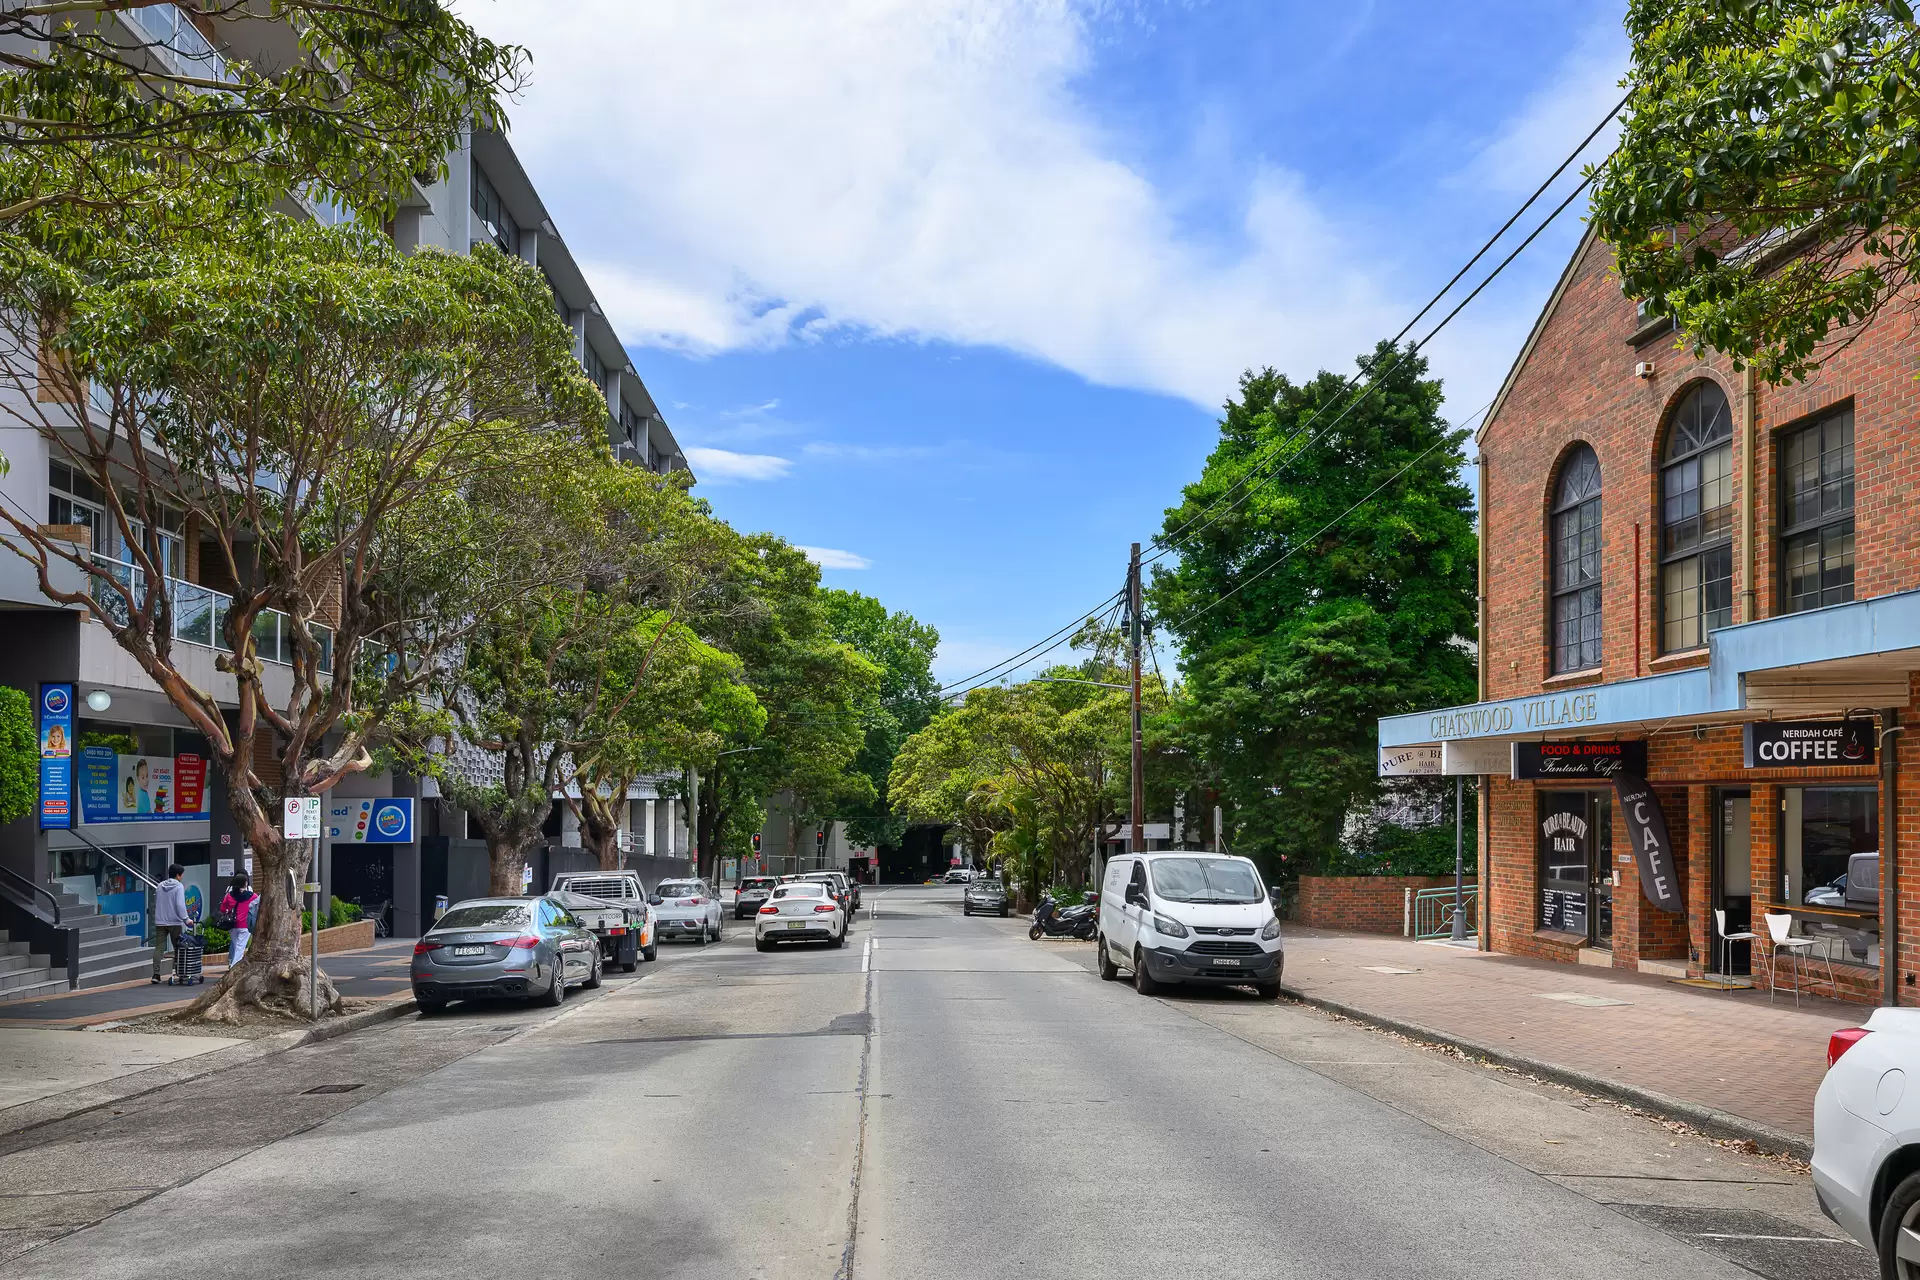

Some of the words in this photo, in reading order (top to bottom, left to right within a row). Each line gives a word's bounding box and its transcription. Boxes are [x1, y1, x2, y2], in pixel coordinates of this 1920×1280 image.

[1430, 706, 1513, 739] CHATSWOOD
[1523, 693, 1597, 727] VILLAGE
[1782, 729, 1820, 738] NERIDAH
[1822, 727, 1843, 738] CAFÉ
[1541, 746, 1570, 755] FOOD
[1572, 746, 1580, 754] &
[1584, 745, 1621, 754] DRINKS
[1759, 740, 1838, 760] COFFEE
[1382, 751, 1414, 772] PURE
[1539, 757, 1588, 773] Fantastic
[1624, 792, 1647, 802] NERDH
[1543, 814, 1558, 838] PURE
[1562, 812, 1587, 840] BEAUTY
[1554, 838, 1575, 852] HAIR
[1634, 802, 1670, 900] CAFE
